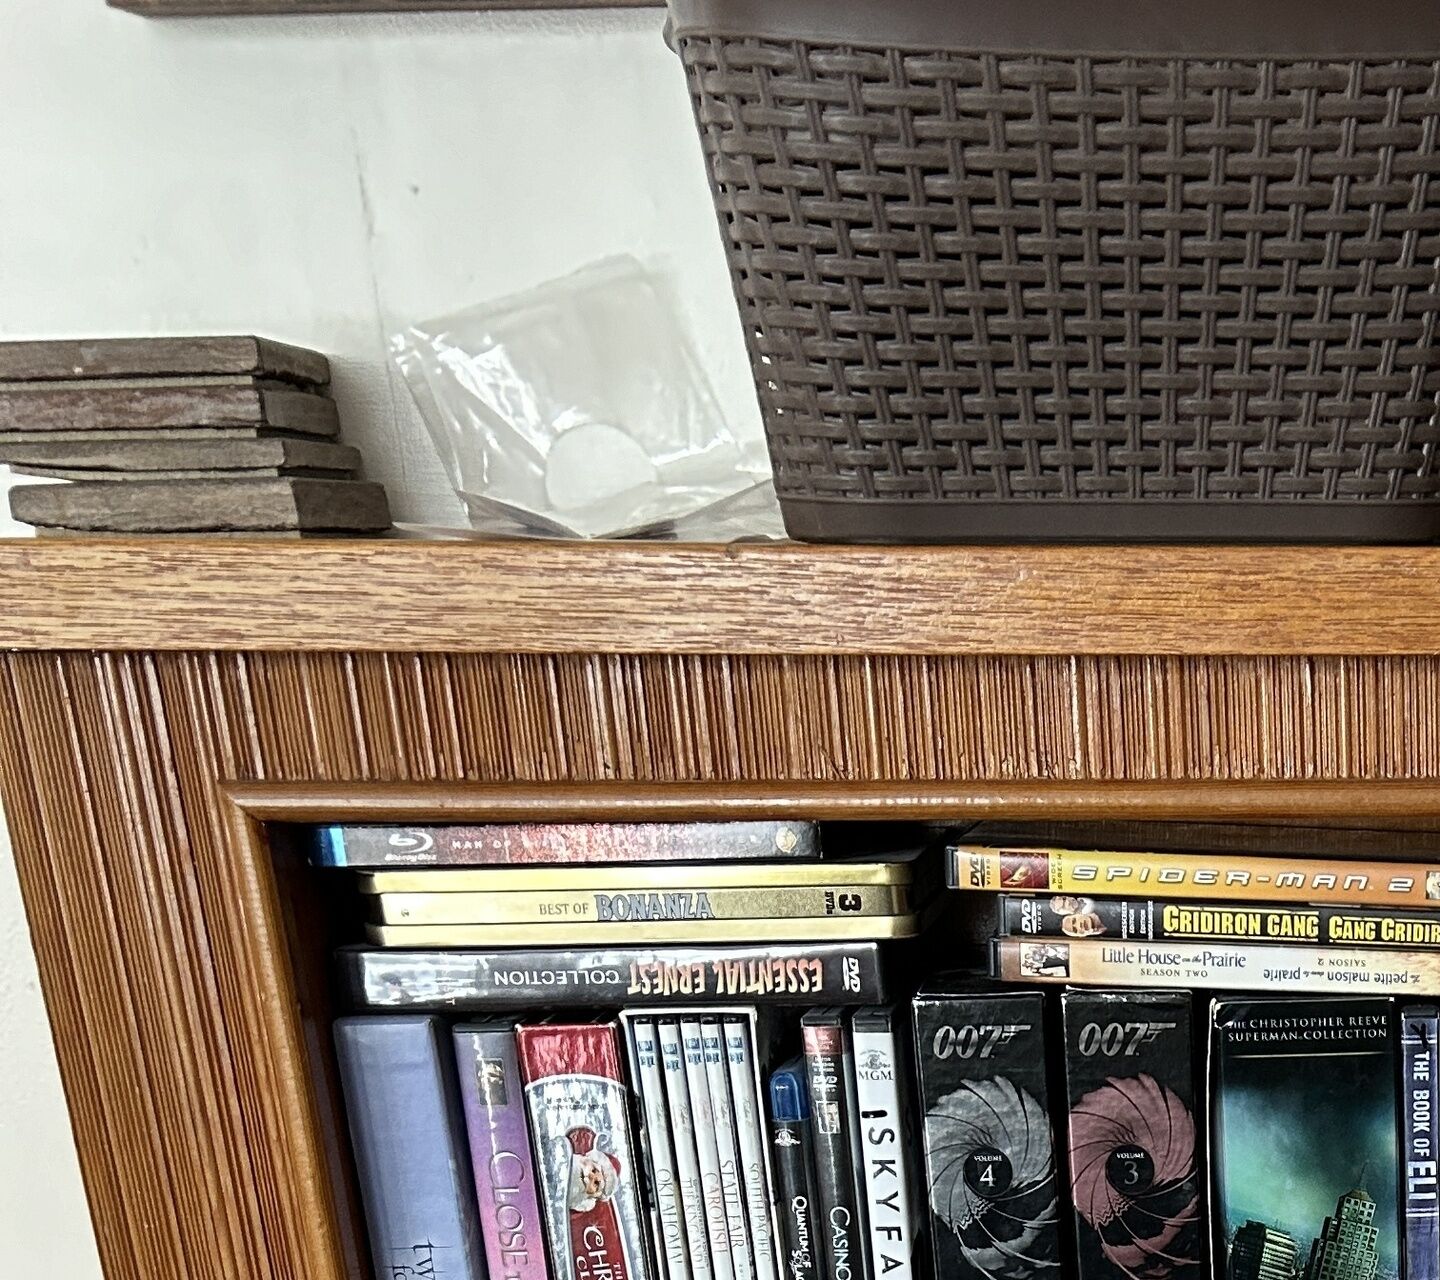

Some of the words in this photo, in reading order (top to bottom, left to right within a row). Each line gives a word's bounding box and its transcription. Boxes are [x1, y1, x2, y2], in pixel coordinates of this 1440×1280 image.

[1072, 863, 1368, 891] SPIDER-MAN
[1387, 877, 1416, 894] 2
[539, 903, 568, 917] BEST
[574, 903, 589, 916] OF
[594, 892, 716, 922] BONANZA
[1163, 905, 1261, 937] GRIDIRON
[1266, 907, 1319, 939] GANG
[1102, 948, 1135, 965] Little
[1138, 947, 1182, 966] House
[1202, 950, 1246, 970] Prairie
[1140, 968, 1178, 978] SEASON
[1181, 969, 1209, 979] TWO
[494, 969, 619, 986] COLLECTION
[629, 961, 707, 997] ERNEST
[714, 956, 824, 996] ESSENTIAL
[1228, 1030, 1298, 1042] SUPERMAN
[1302, 1028, 1387, 1041] COLLECTION
[1249, 1016, 1345, 1029] CHRISTOPHER
[1350, 1016, 1387, 1025] REEVE
[933, 1024, 1022, 1060] 007
[1078, 1023, 1167, 1057] 007
[1413, 1050, 1430, 1084] THE
[1412, 1087, 1430, 1134] BOOK
[1413, 1136, 1429, 1156] OF
[1408, 1160, 1437, 1201] ELI
[488, 1150, 529, 1266] CLOSE
